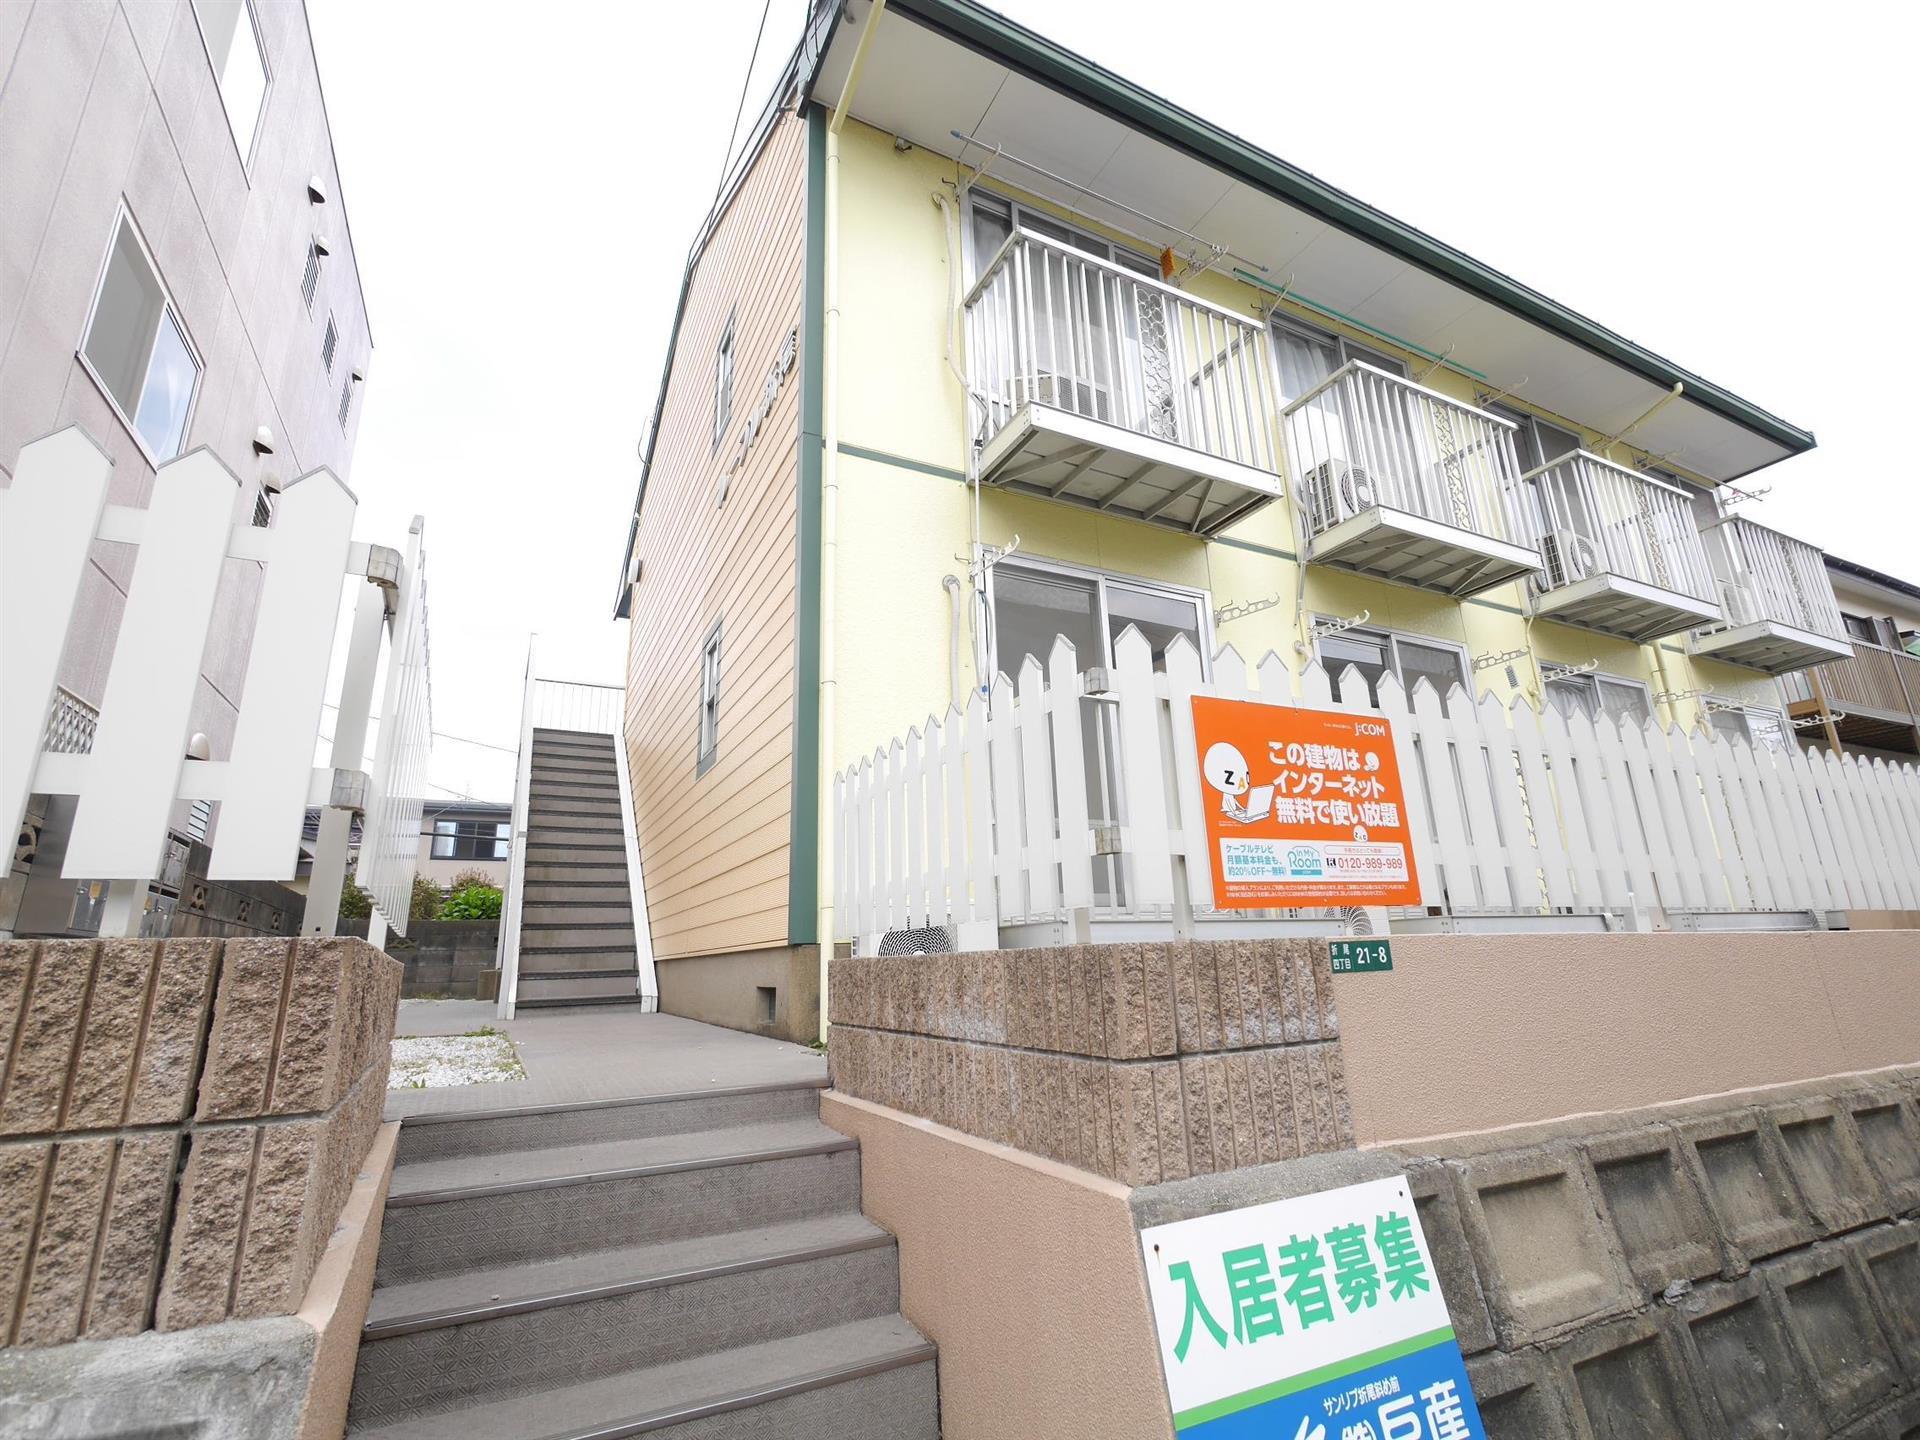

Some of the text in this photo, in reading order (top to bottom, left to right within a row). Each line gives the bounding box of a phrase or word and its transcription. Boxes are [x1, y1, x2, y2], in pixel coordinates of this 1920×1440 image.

[1268, 741, 1360, 771] この建物は
[1273, 769, 1385, 799] インターネット
[1275, 796, 1401, 828] 無料で使い放題
[1226, 845, 1274, 854] ケーブルテレビ
[1338, 857, 1403, 869] 0120-989-989
[1333, 958, 1351, 970] 四丁目
[1356, 946, 1387, 964] 21-8
[1168, 1210, 1430, 1364] 入居者募集
[1322, 1375, 1401, 1417] サンリブ折尾斜め前
